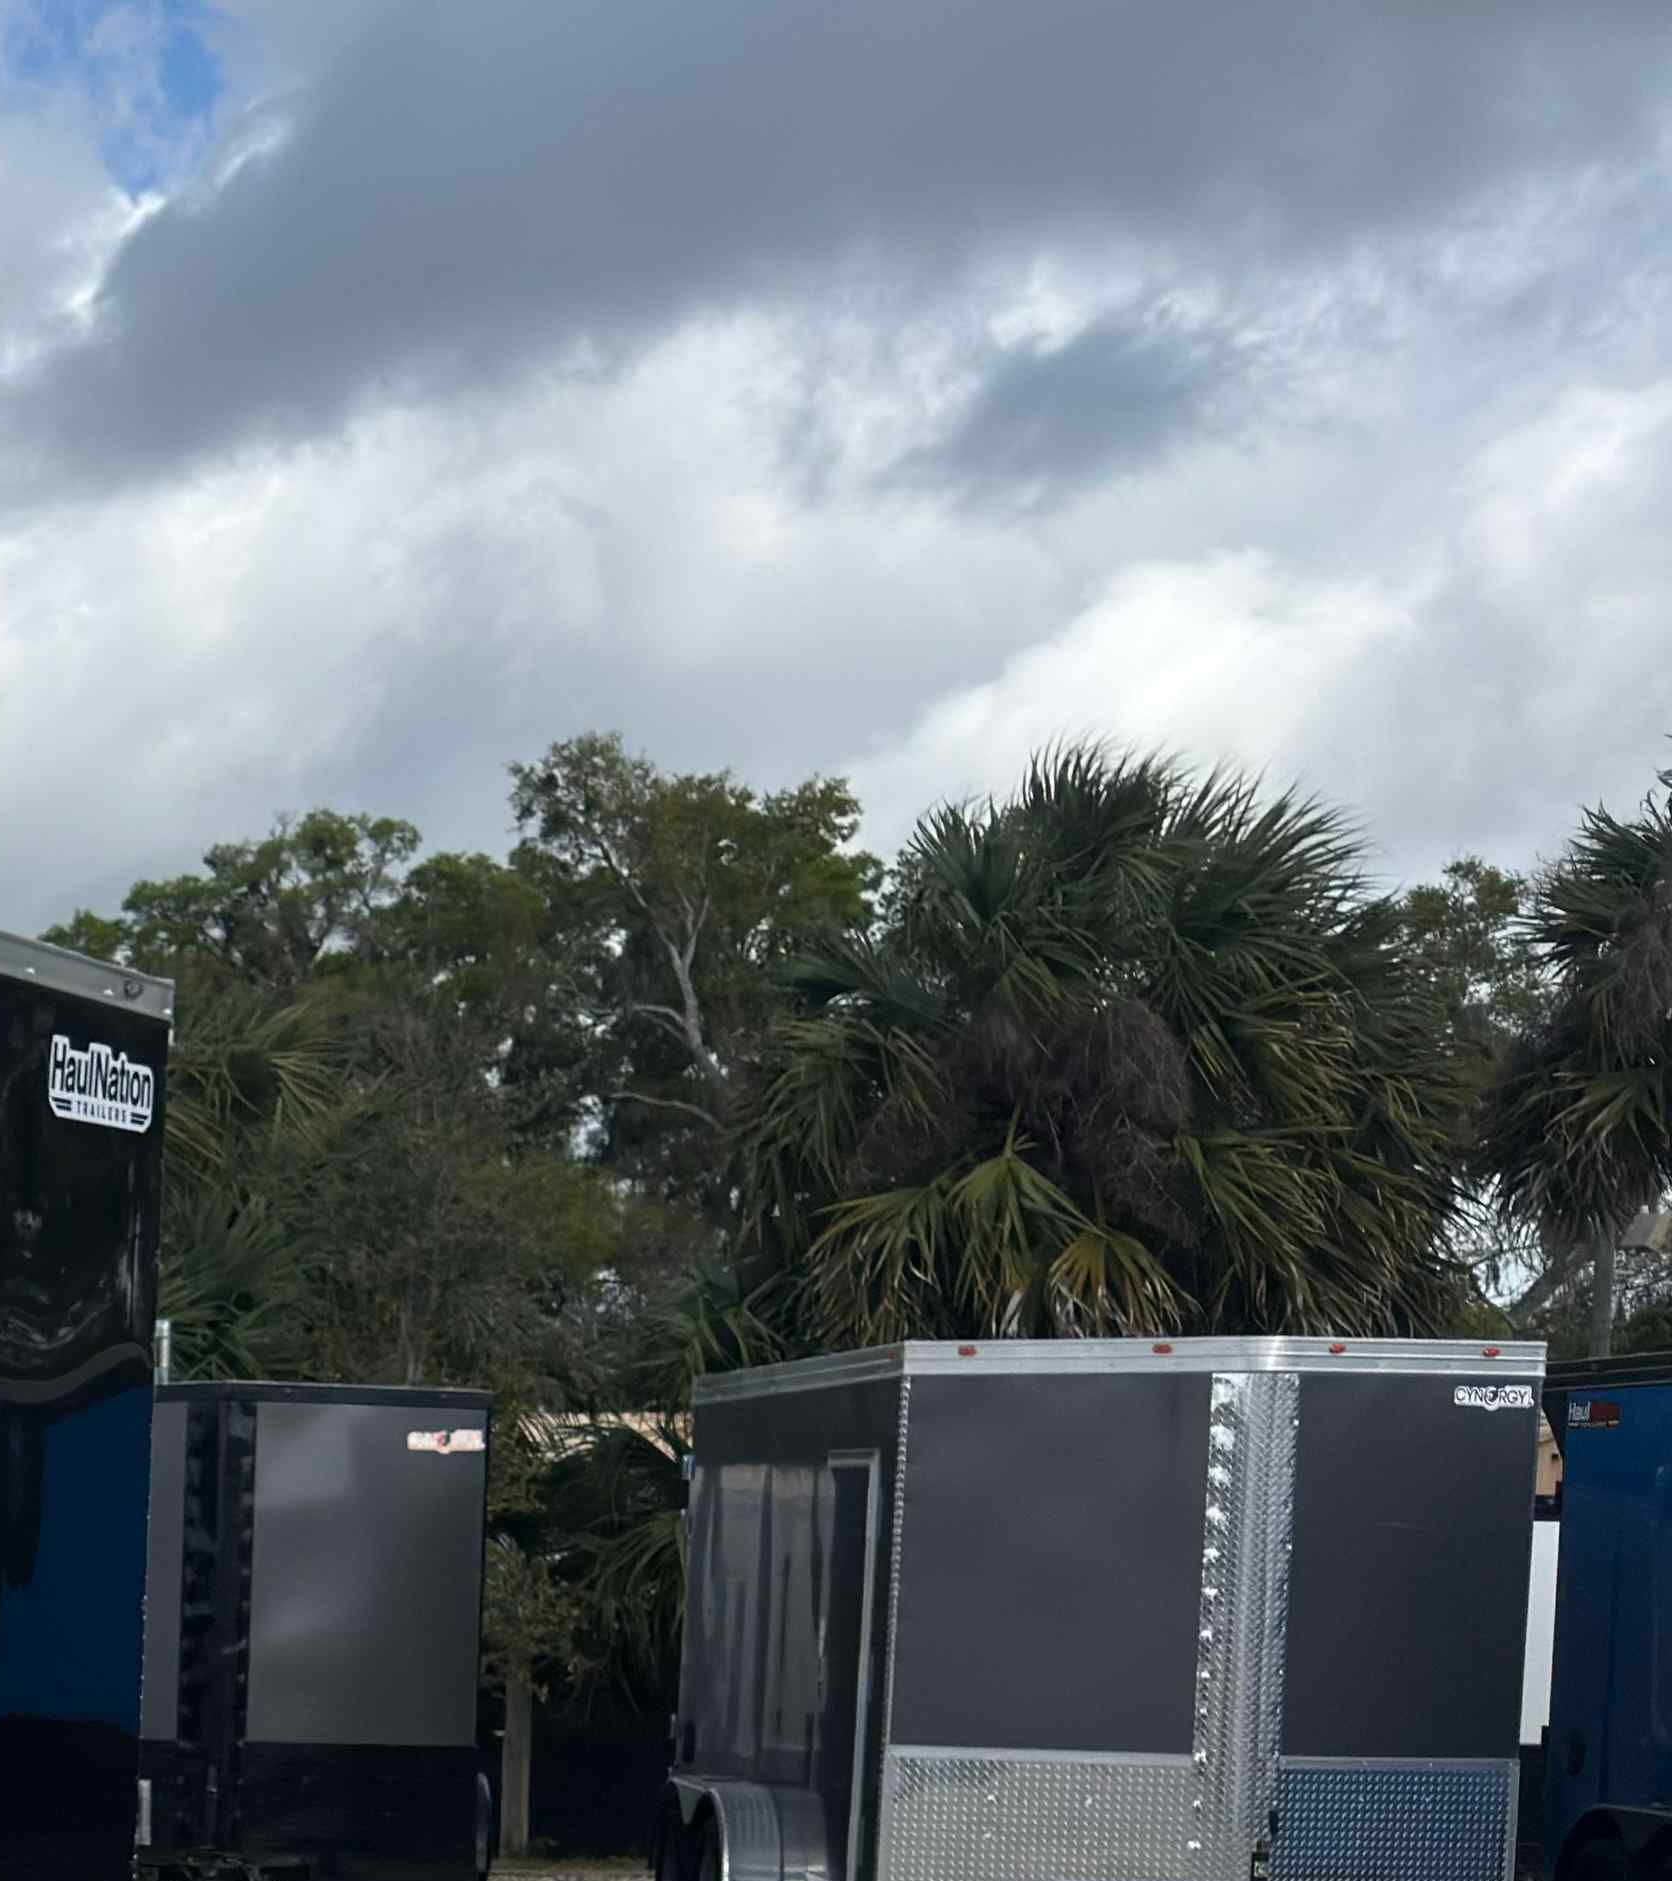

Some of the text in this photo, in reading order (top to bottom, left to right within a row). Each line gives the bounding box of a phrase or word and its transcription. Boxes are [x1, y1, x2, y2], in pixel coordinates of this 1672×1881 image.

[51, 1041, 151, 1109] HaulNation
[76, 1100, 127, 1124] TRAILERS
[1455, 1385, 1529, 1409] CYNERGY
